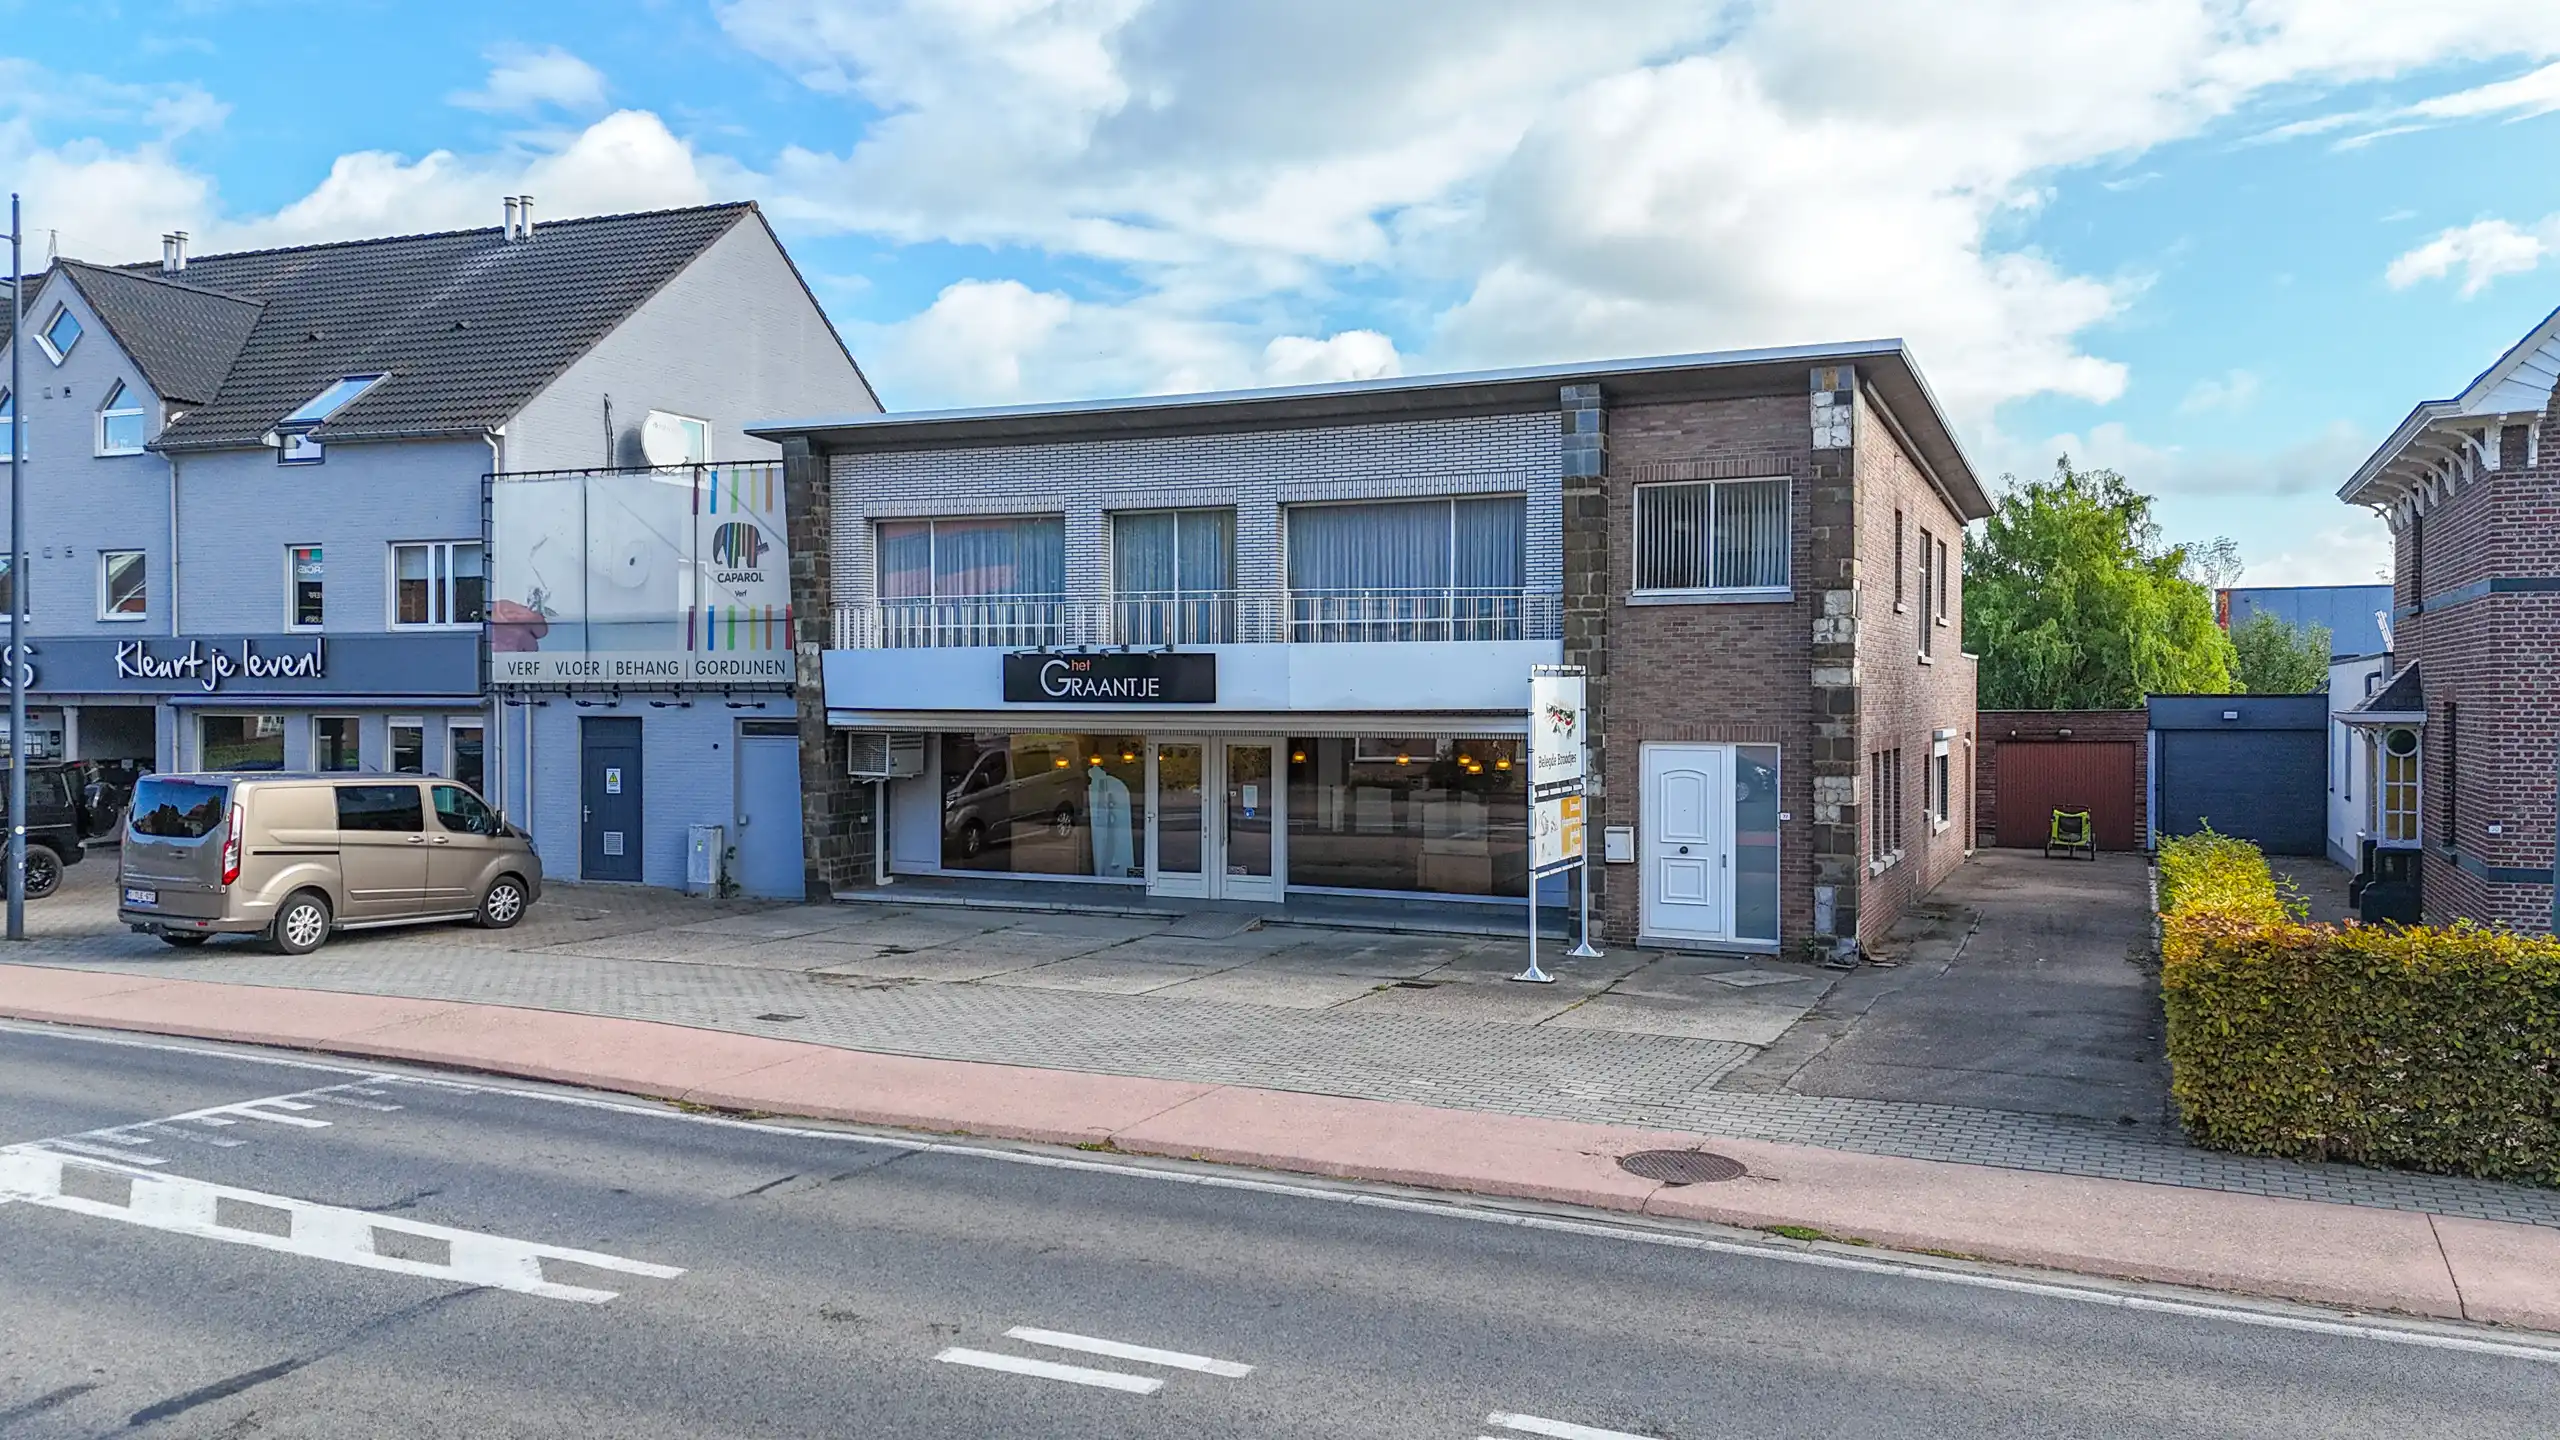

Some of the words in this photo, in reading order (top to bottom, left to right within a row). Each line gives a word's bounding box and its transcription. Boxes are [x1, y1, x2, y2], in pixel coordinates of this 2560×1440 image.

[717, 572, 764, 583] CAPAROL
[734, 588, 748, 597] Verf
[114, 640, 203, 678] Kleurt
[201, 648, 235, 692] je
[243, 637, 323, 678] leven!
[507, 660, 540, 676] VERF
[555, 660, 600, 676] VLOER
[616, 660, 679, 676] BEHANG
[695, 659, 786, 676] GORDIJNEN
[1071, 659, 1092, 671] het
[1040, 659, 1160, 697] GRAANTJE
[1538, 753, 1557, 770] Belegde
